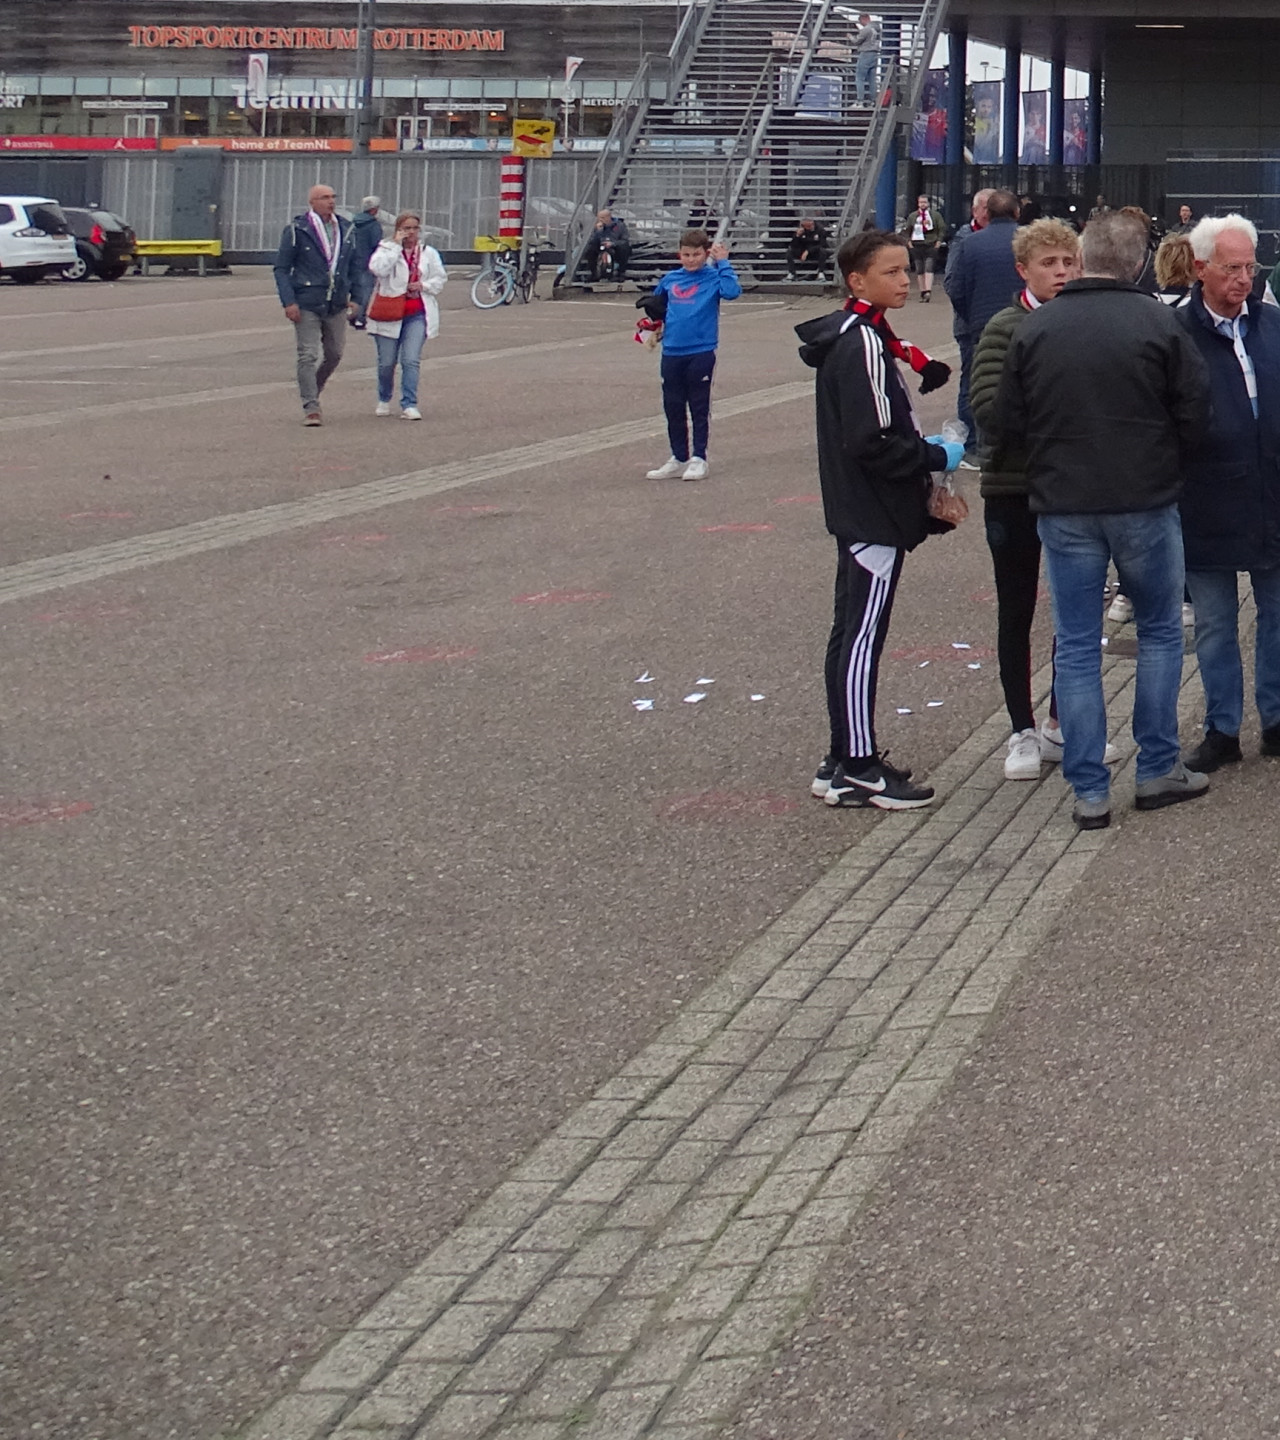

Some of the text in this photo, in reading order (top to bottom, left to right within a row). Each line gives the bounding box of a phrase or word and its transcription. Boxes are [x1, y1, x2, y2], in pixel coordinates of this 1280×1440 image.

[128, 25, 359, 50] TOPSPORTCENTRUM
[231, 139, 331, 150] home of TeamNL
